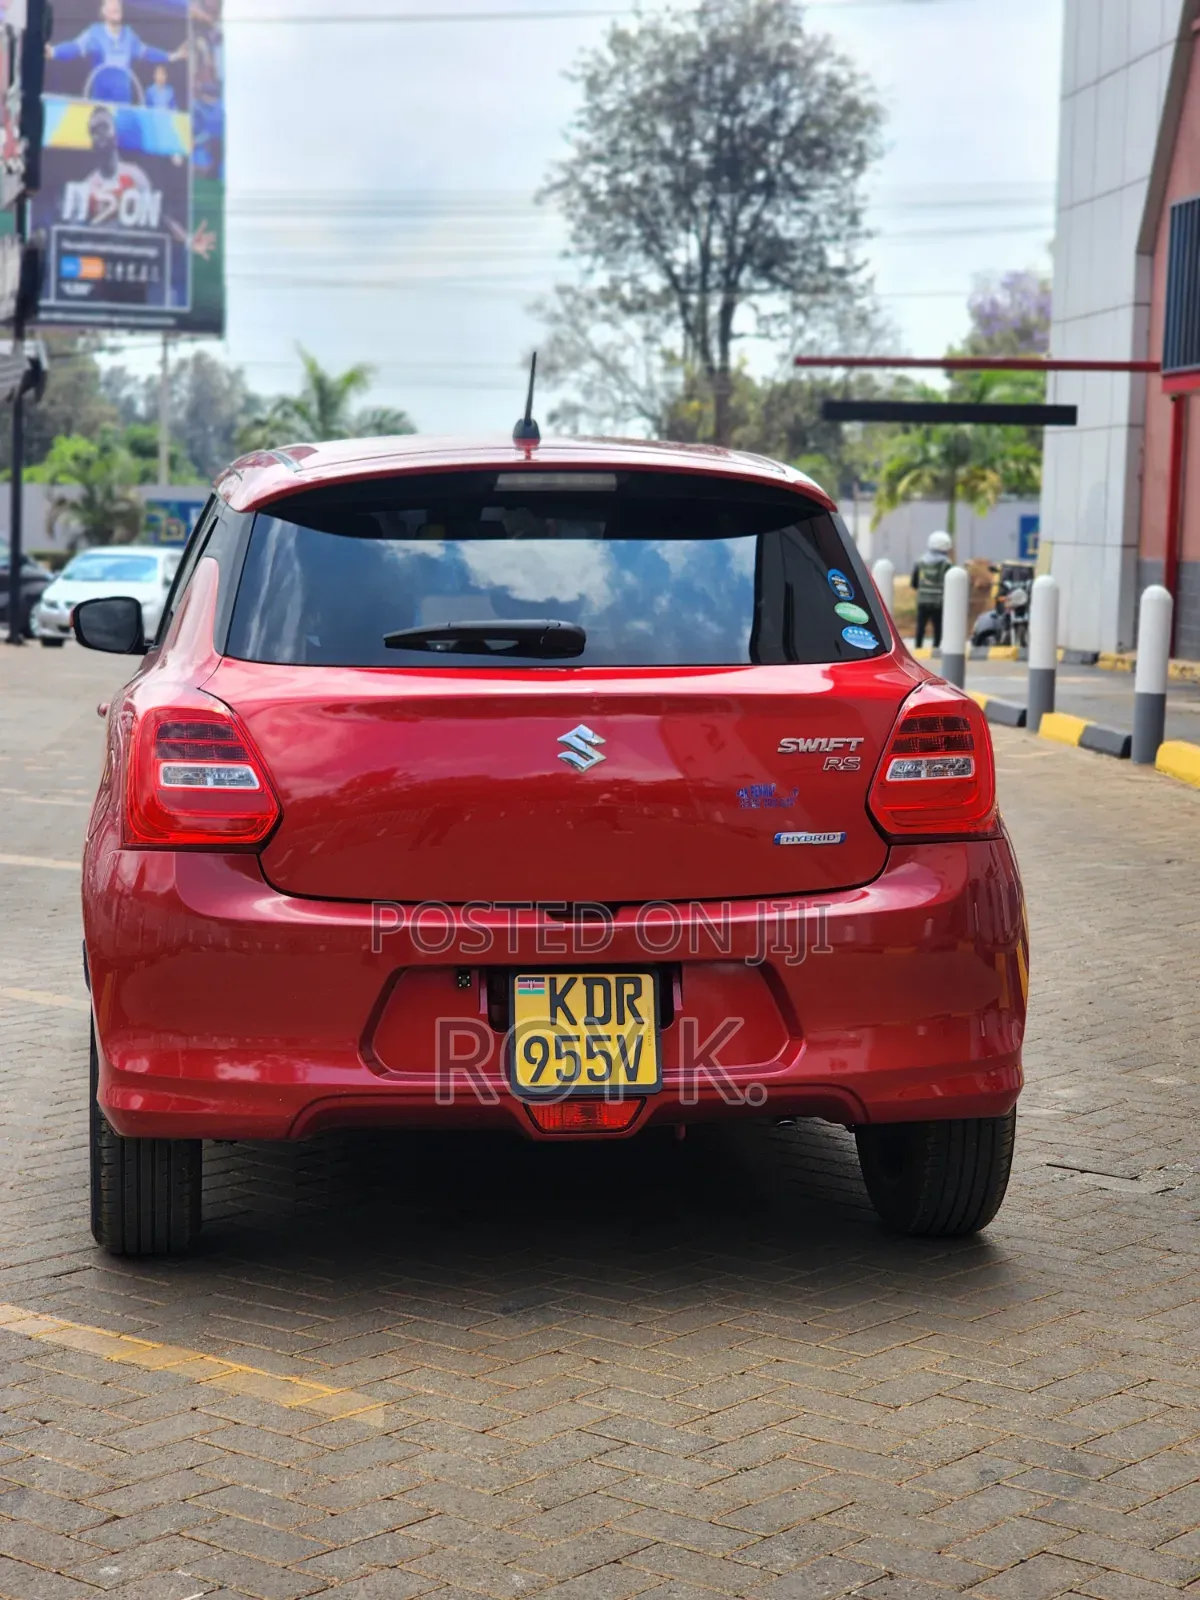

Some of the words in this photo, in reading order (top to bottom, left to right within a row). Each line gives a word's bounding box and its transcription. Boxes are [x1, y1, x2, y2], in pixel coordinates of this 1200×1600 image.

[777, 737, 865, 753] SWIFT
[822, 756, 861, 771] RS
[785, 834, 837, 843] HYBRID
[549, 976, 645, 1026] KDR
[523, 1034, 644, 1083] 955V
